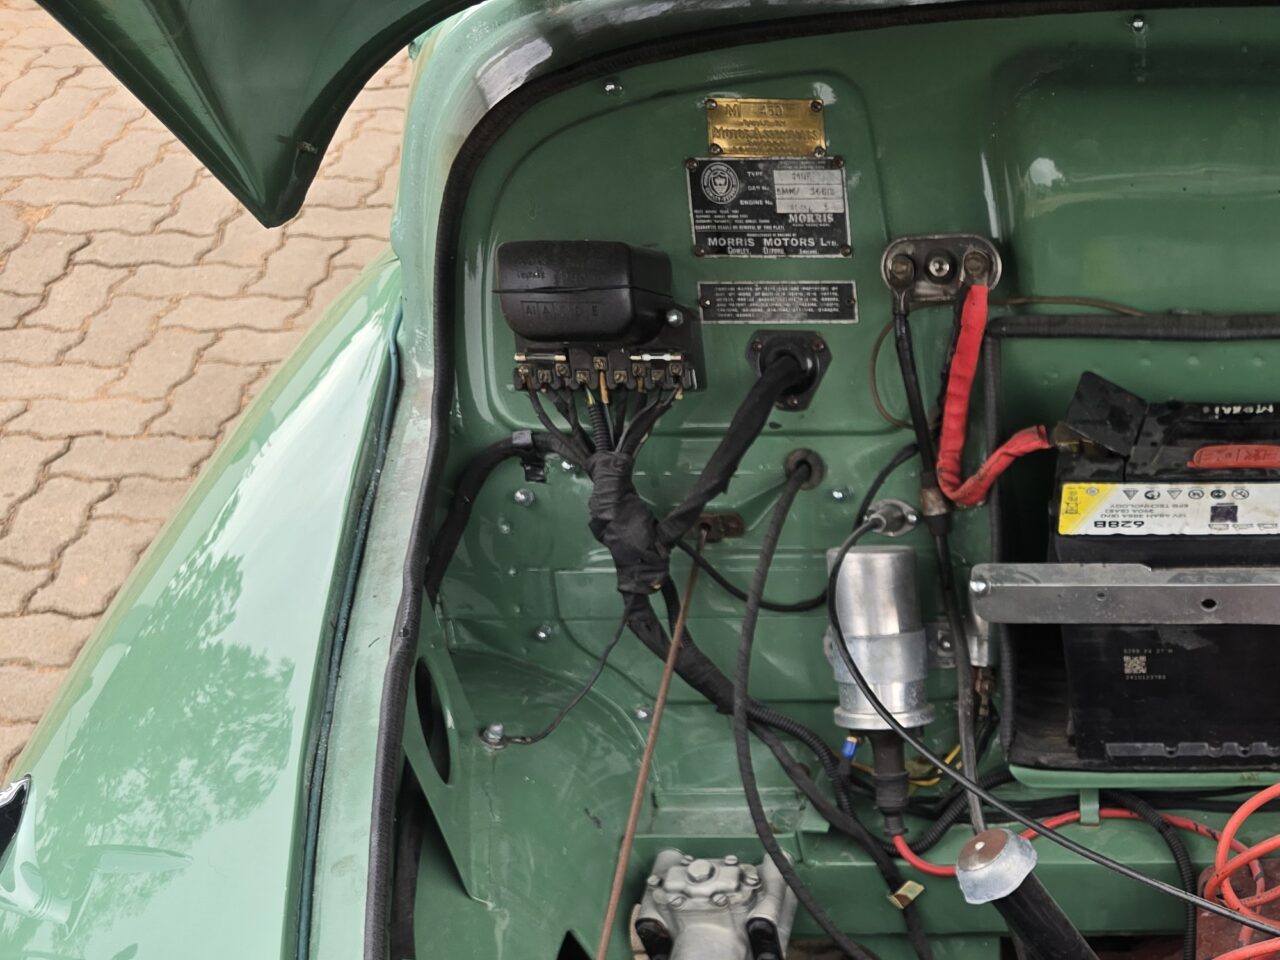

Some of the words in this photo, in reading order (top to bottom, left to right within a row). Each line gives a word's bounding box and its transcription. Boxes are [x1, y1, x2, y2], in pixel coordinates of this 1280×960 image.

[788, 213, 834, 224] MORRIS
[707, 236, 756, 247] MORRIS
[762, 237, 816, 247] MOTORS
[1094, 520, 1145, 528] 628B
